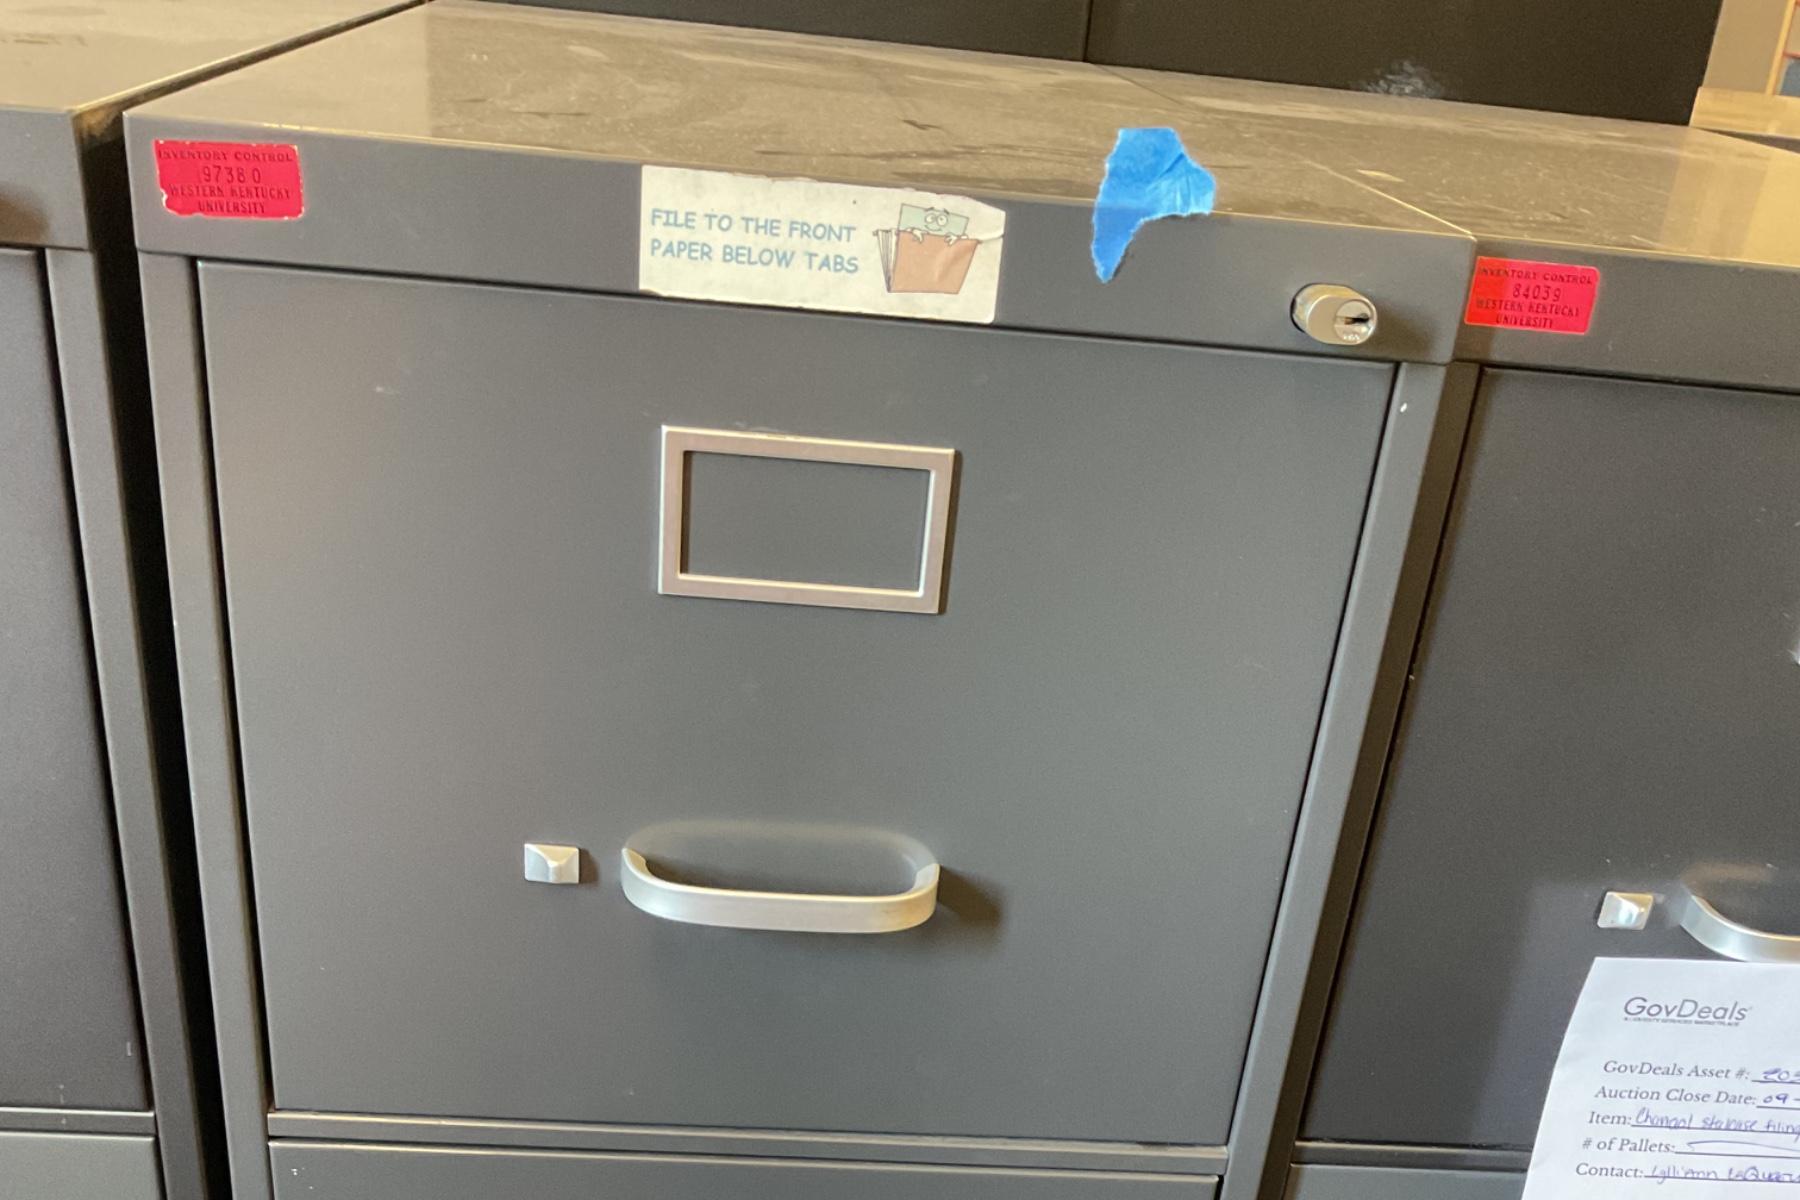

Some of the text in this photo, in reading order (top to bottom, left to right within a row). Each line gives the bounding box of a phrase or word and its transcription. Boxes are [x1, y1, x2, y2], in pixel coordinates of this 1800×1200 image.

[158, 150, 293, 162] INVENTORY CONTROL
[169, 184, 291, 200] WESTERN KENTUCKY
[197, 201, 265, 214] UNIVERSITY
[650, 208, 856, 243] FILE TO THE FRONT
[650, 238, 859, 274] PAPER BELOW TABS
[1478, 267, 1593, 285] INVENTORY CONTROL
[1512, 283, 1562, 302] 84039
[1476, 299, 1580, 317] WESTERN KENTUCKY
[1495, 315, 1554, 329] UNIVERSITY
[1623, 996, 1749, 1021] GovDeals
[1603, 1060, 1684, 1077] GovDeals
[1687, 1064, 1731, 1079] Asset
[1594, 1085, 1757, 1105] Auction Close Date:
[1588, 1111, 1632, 1126] Item:
[1582, 1137, 1676, 1154] # of Pallets:
[1575, 1162, 1645, 1179] Contact:
